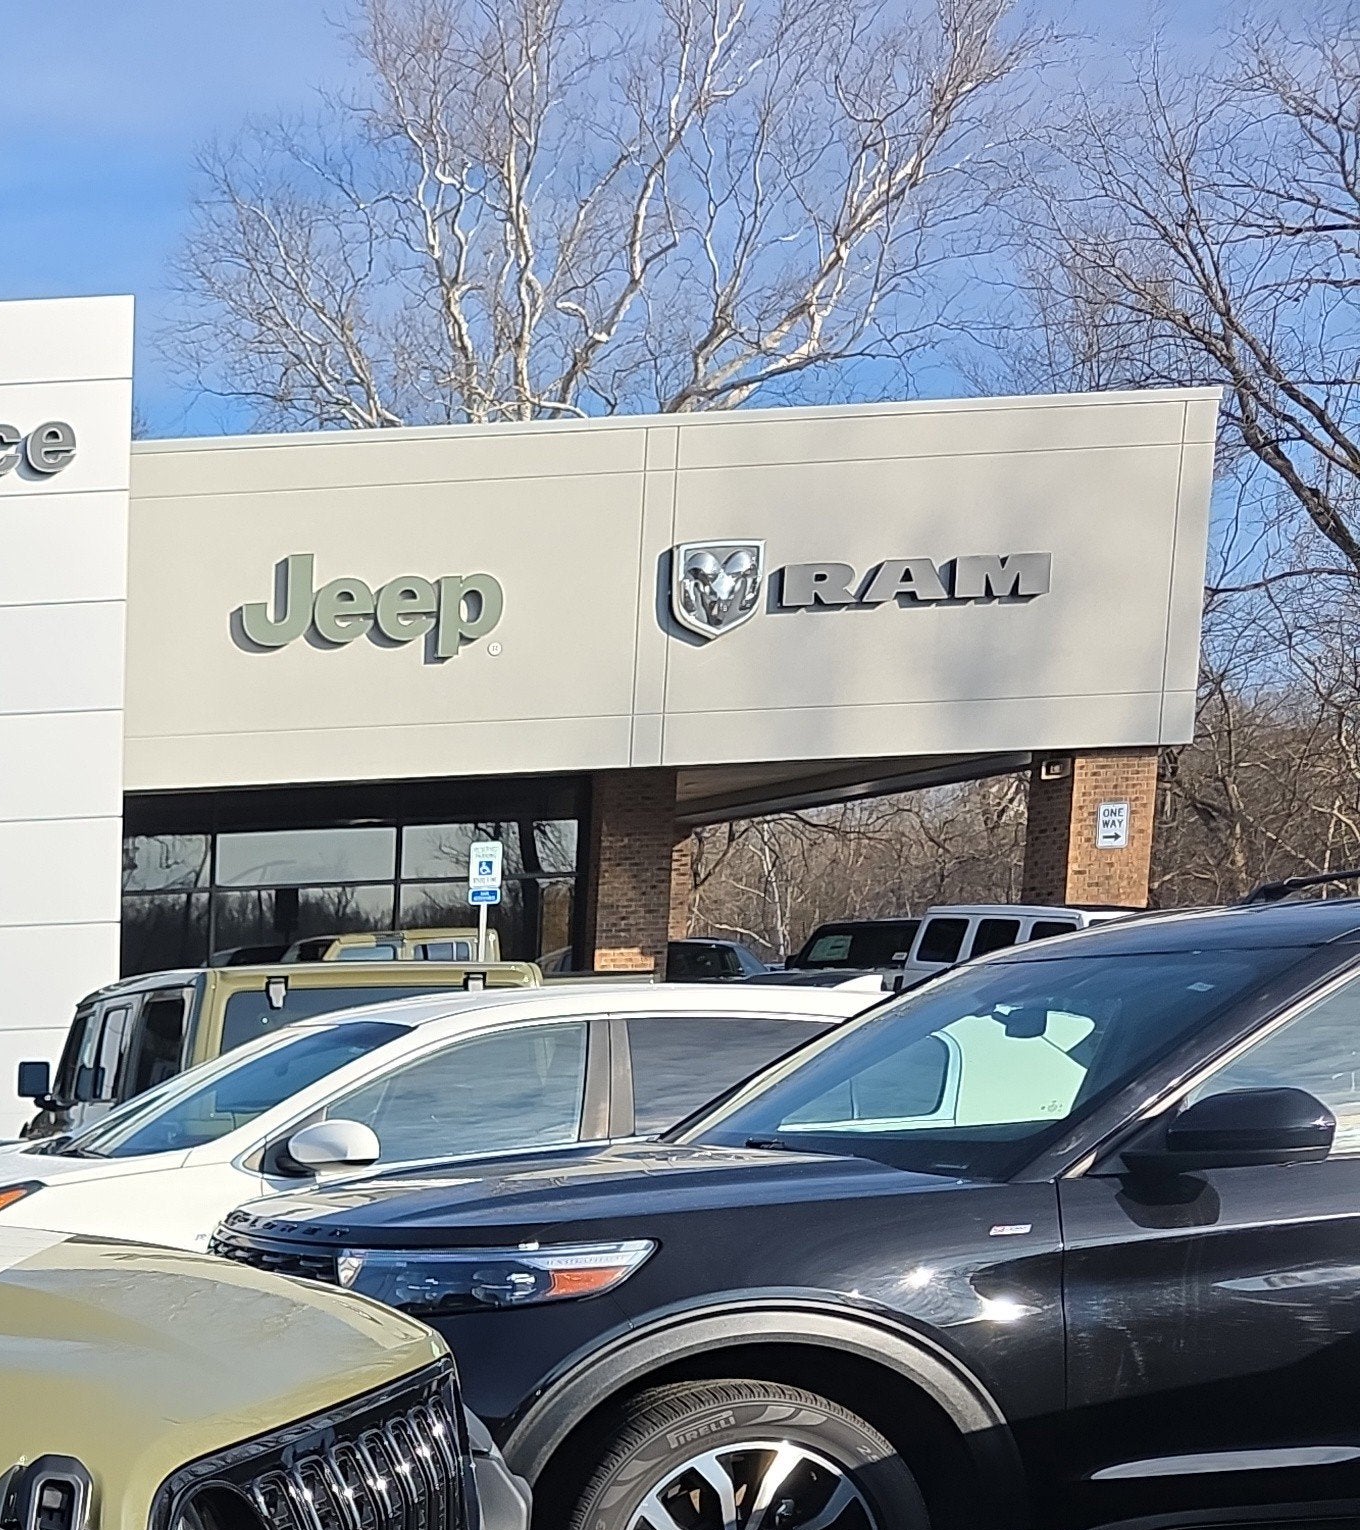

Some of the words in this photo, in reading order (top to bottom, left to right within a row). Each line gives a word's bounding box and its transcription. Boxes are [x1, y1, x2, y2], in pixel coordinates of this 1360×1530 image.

[768, 553, 1051, 614] RAM
[231, 554, 503, 664] Jeep
[1102, 808, 1124, 818] ONE
[1102, 819, 1124, 829] WAY
[666, 1410, 736, 1449] PIRELLI
